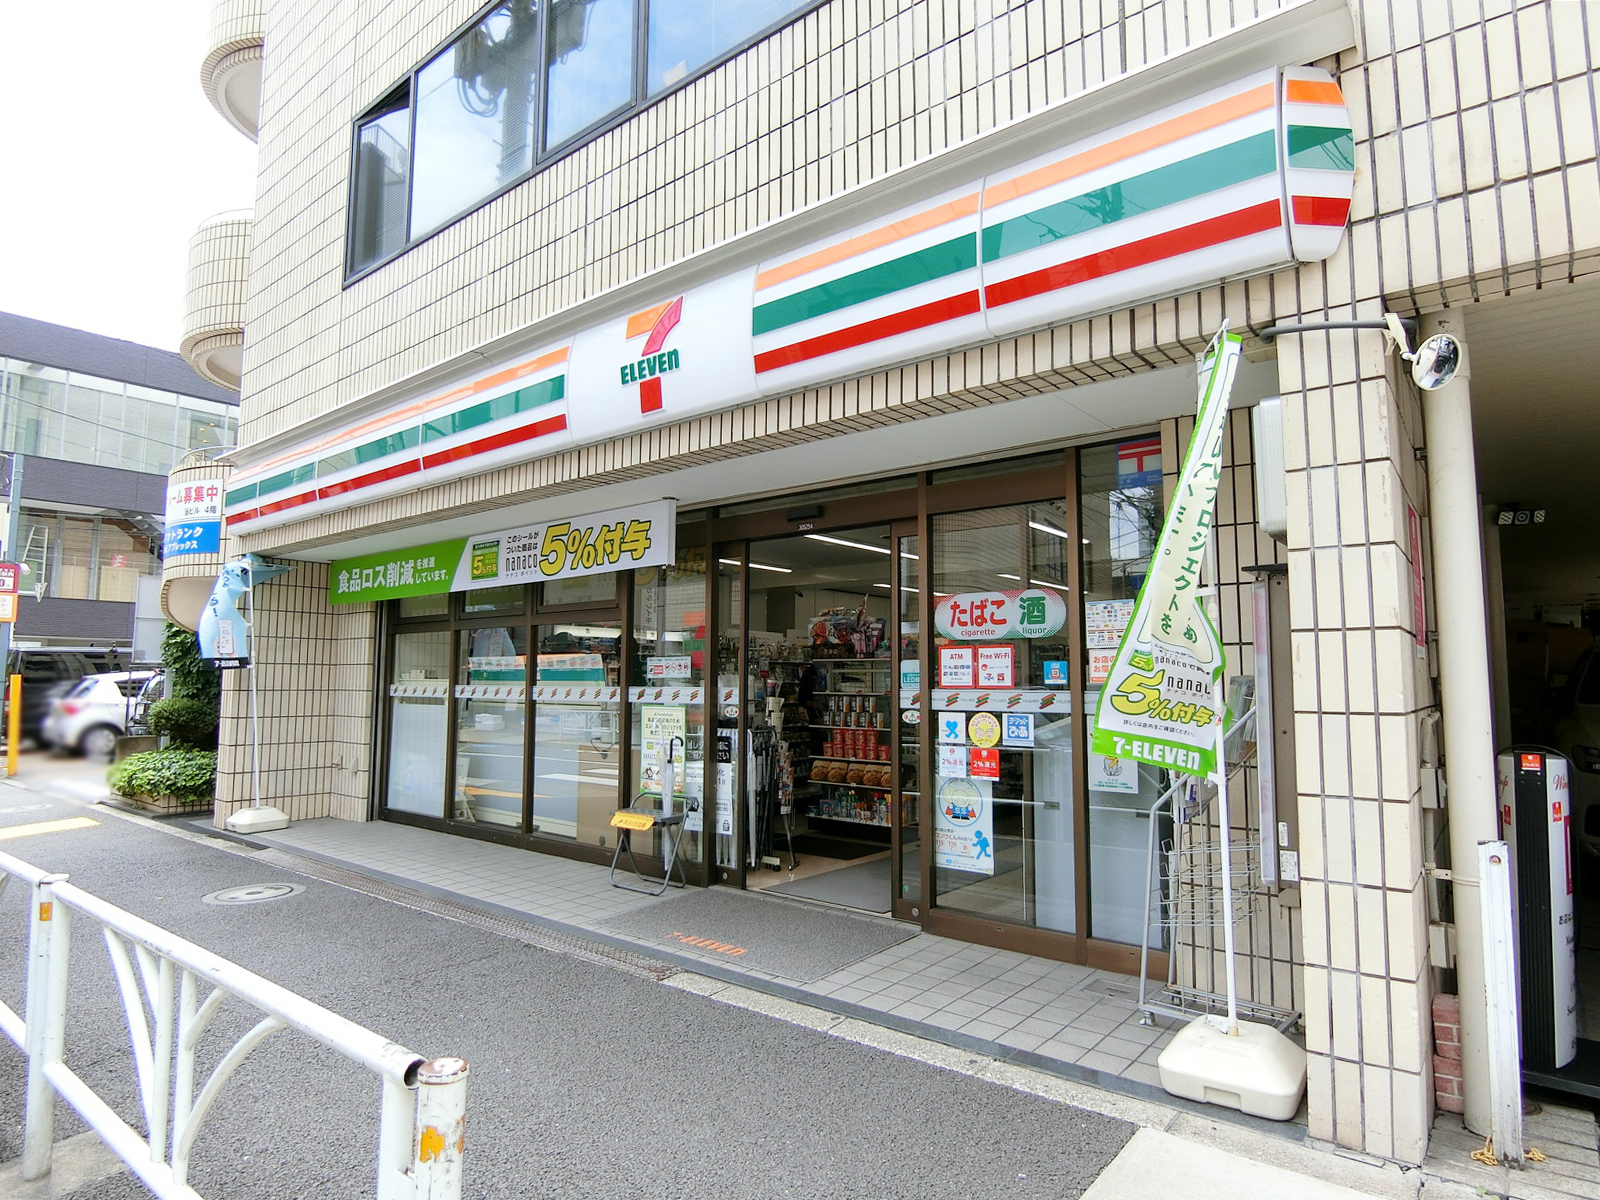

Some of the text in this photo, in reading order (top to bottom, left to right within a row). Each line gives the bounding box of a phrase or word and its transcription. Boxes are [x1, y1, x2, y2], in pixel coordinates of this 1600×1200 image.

[507, 531, 539, 544] このシールが
[539, 519, 652, 576] 5%付与
[416, 556, 435, 569] を推進
[505, 553, 538, 572] nanaco
[338, 559, 415, 594] 食品ロス削減
[950, 596, 1046, 628] たばこ 酒
[960, 626, 1047, 637] cigarette liquor
[994, 652, 1010, 660] Wi-Fi
[1110, 669, 1215, 727] 5%付与
[1008, 725, 1029, 738] ぴあ
[973, 760, 997, 769] 2%還元
